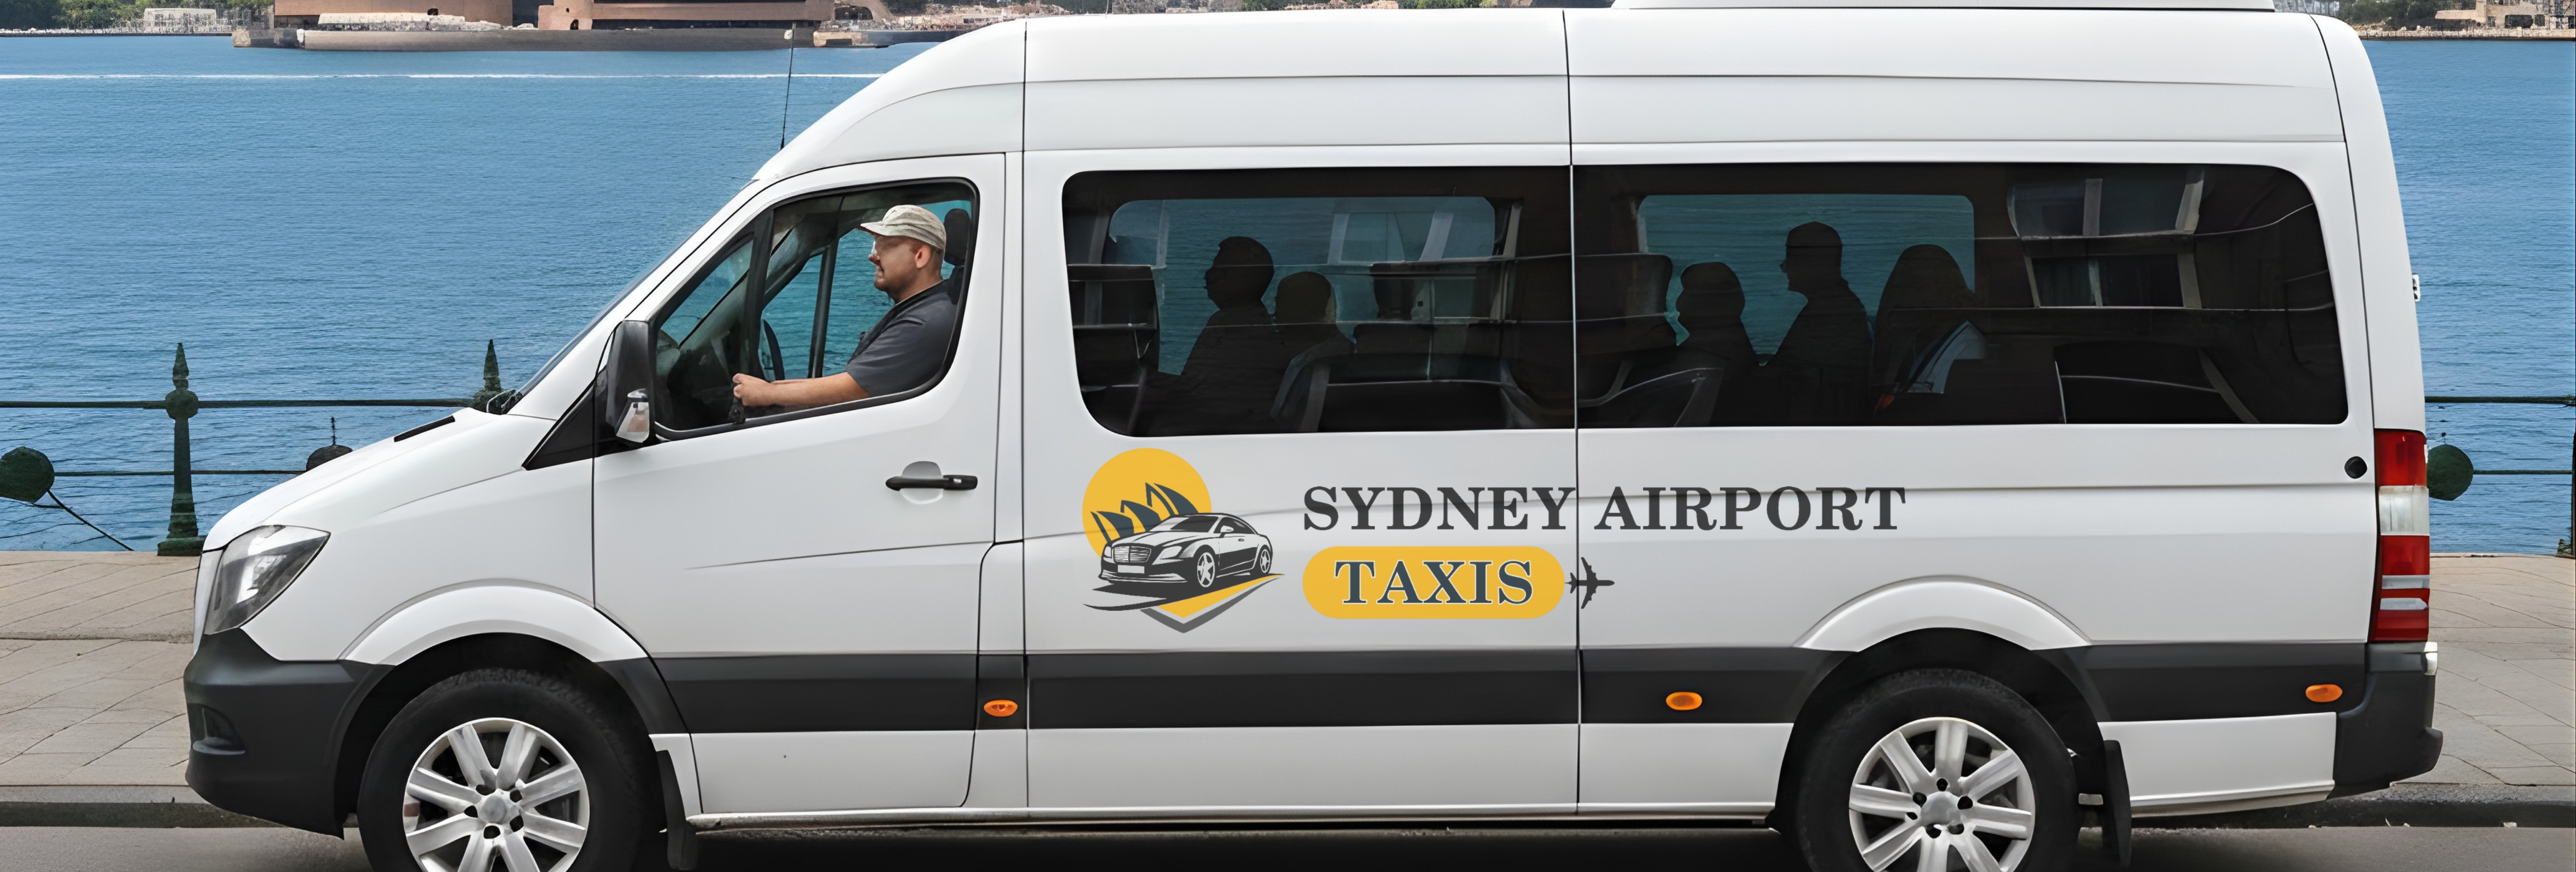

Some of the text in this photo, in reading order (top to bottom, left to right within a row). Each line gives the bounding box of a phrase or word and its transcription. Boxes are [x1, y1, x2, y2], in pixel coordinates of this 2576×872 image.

[1304, 486, 1905, 531] SYDNEY AIRPORT
[1335, 560, 1533, 605] TAXIS
